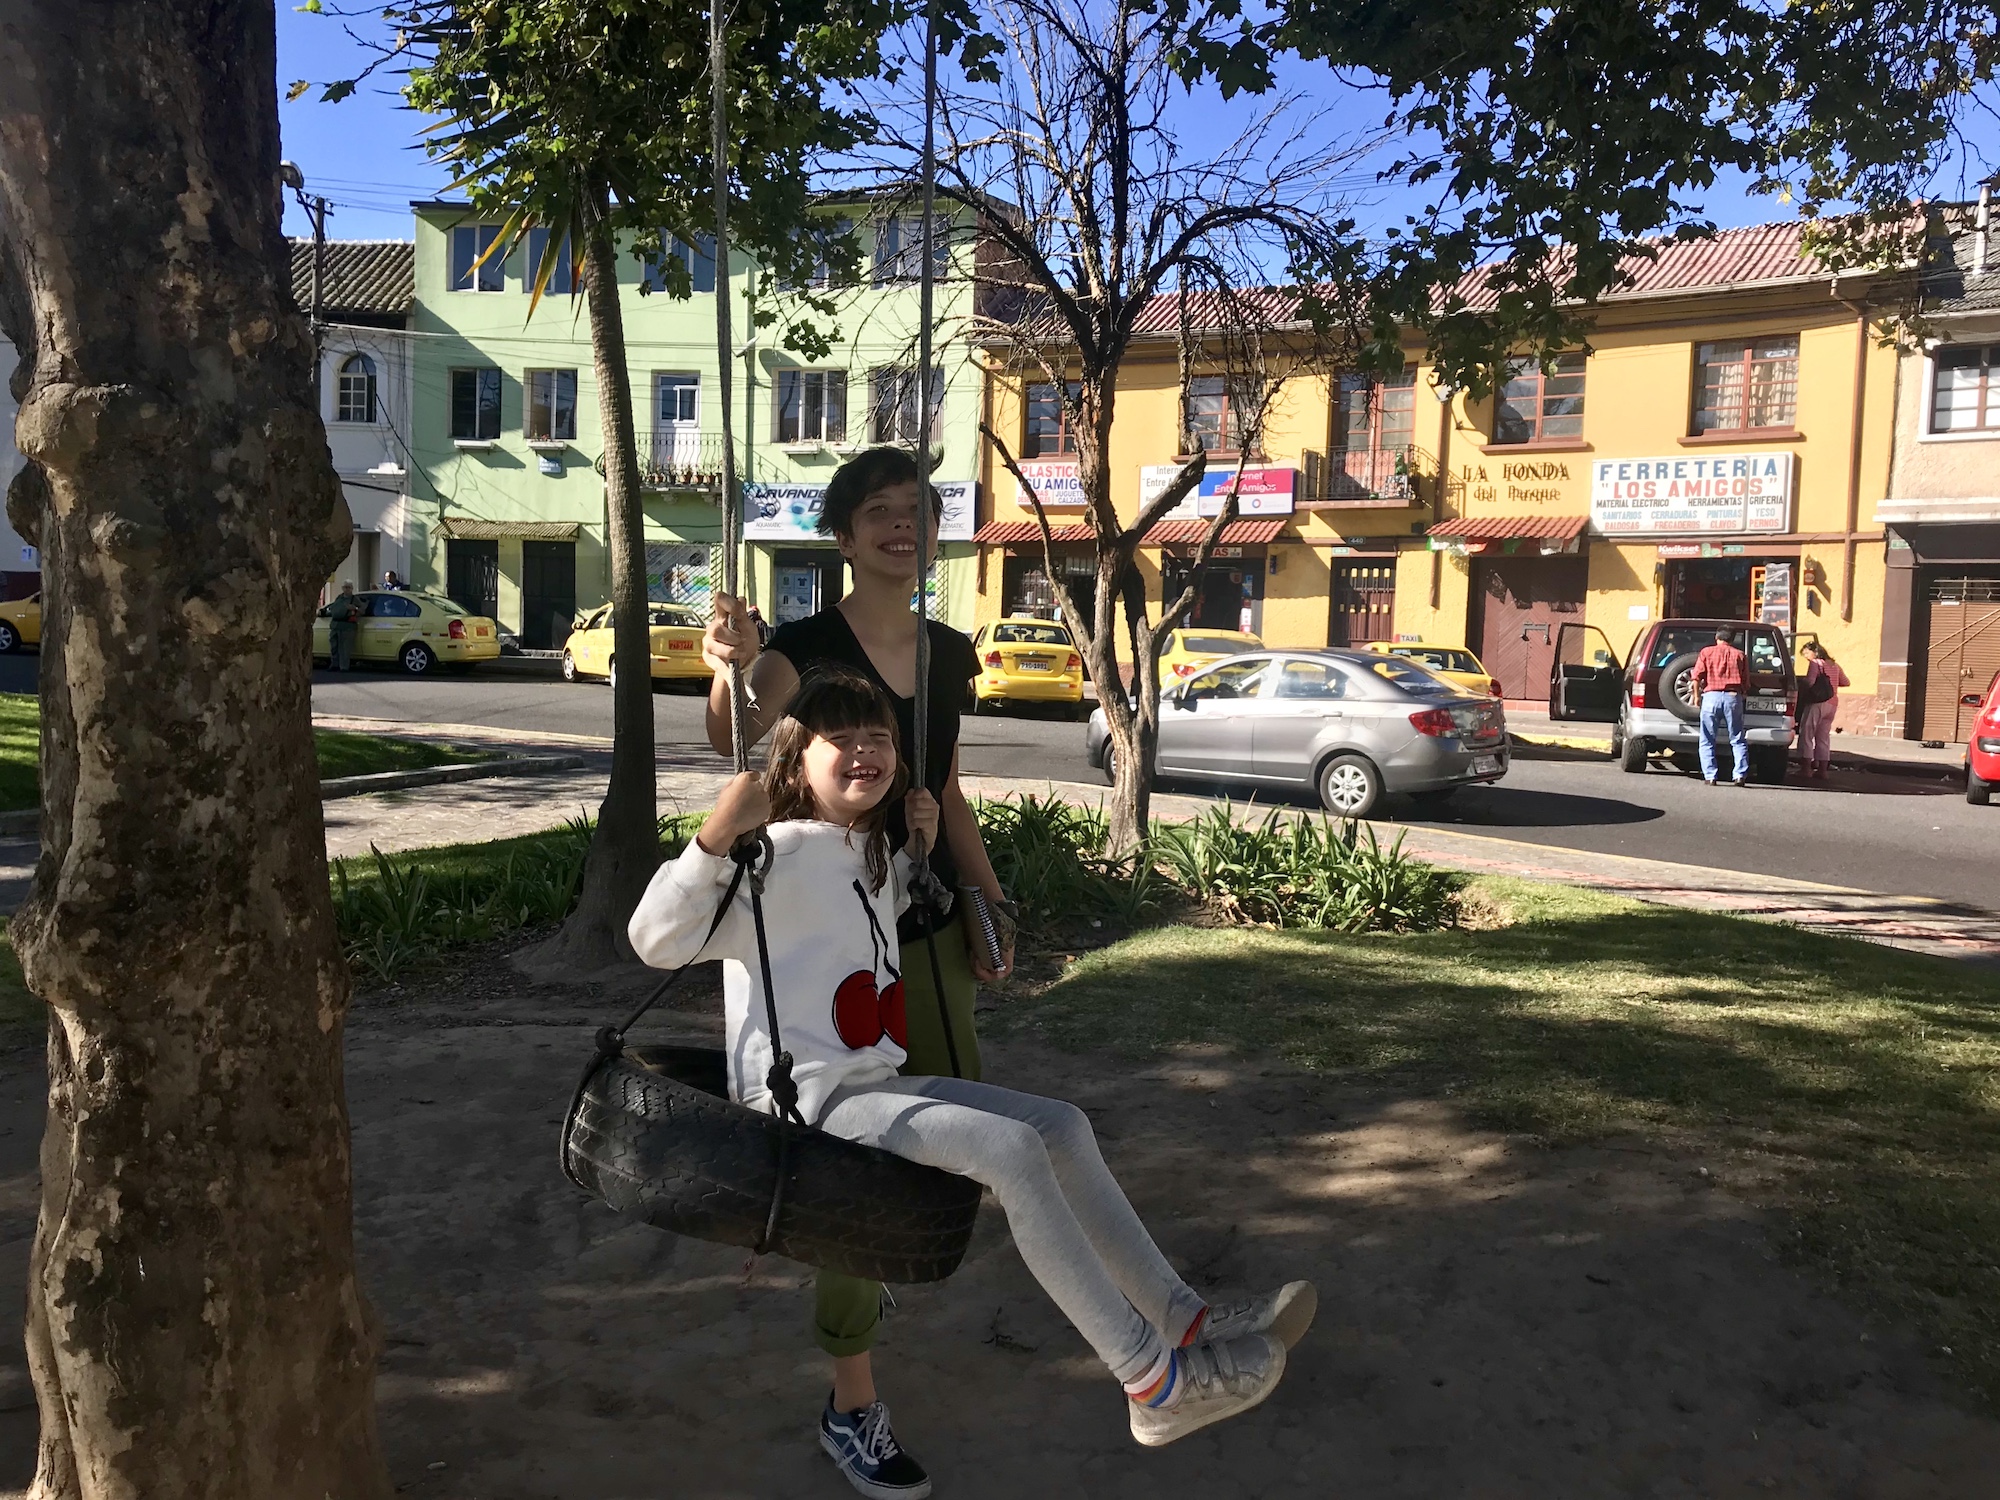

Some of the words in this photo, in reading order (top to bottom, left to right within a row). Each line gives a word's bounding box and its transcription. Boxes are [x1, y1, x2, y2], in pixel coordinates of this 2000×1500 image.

[1463, 464, 1487, 481] LA
[1503, 462, 1569, 481] FONDA
[1600, 458, 1777, 481] FERRETERIA
[1228, 472, 1264, 480] Inernet
[756, 489, 826, 498] LAVANDE
[1214, 484, 1233, 493] Entr
[1474, 485, 1496, 502] del
[1508, 485, 1561, 504] Parque
[1596, 499, 1629, 508] MATERIAL
[1632, 499, 1669, 508] ELECTRICO
[1688, 497, 1742, 507] HERRAMIENTAS
[1749, 496, 1784, 505] GRIFERIA
[1602, 511, 1642, 519] SANITARIOS
[1651, 510, 1698, 519] CERRADURAS
[1707, 509, 1743, 518] PINTURAS
[1755, 508, 1776, 517] YESO
[1605, 521, 1640, 530] BALDOSAS
[1710, 520, 1737, 529] CLAVOS
[1749, 519, 1779, 528] PERNOS
[1658, 545, 1699, 553] Kwikset
